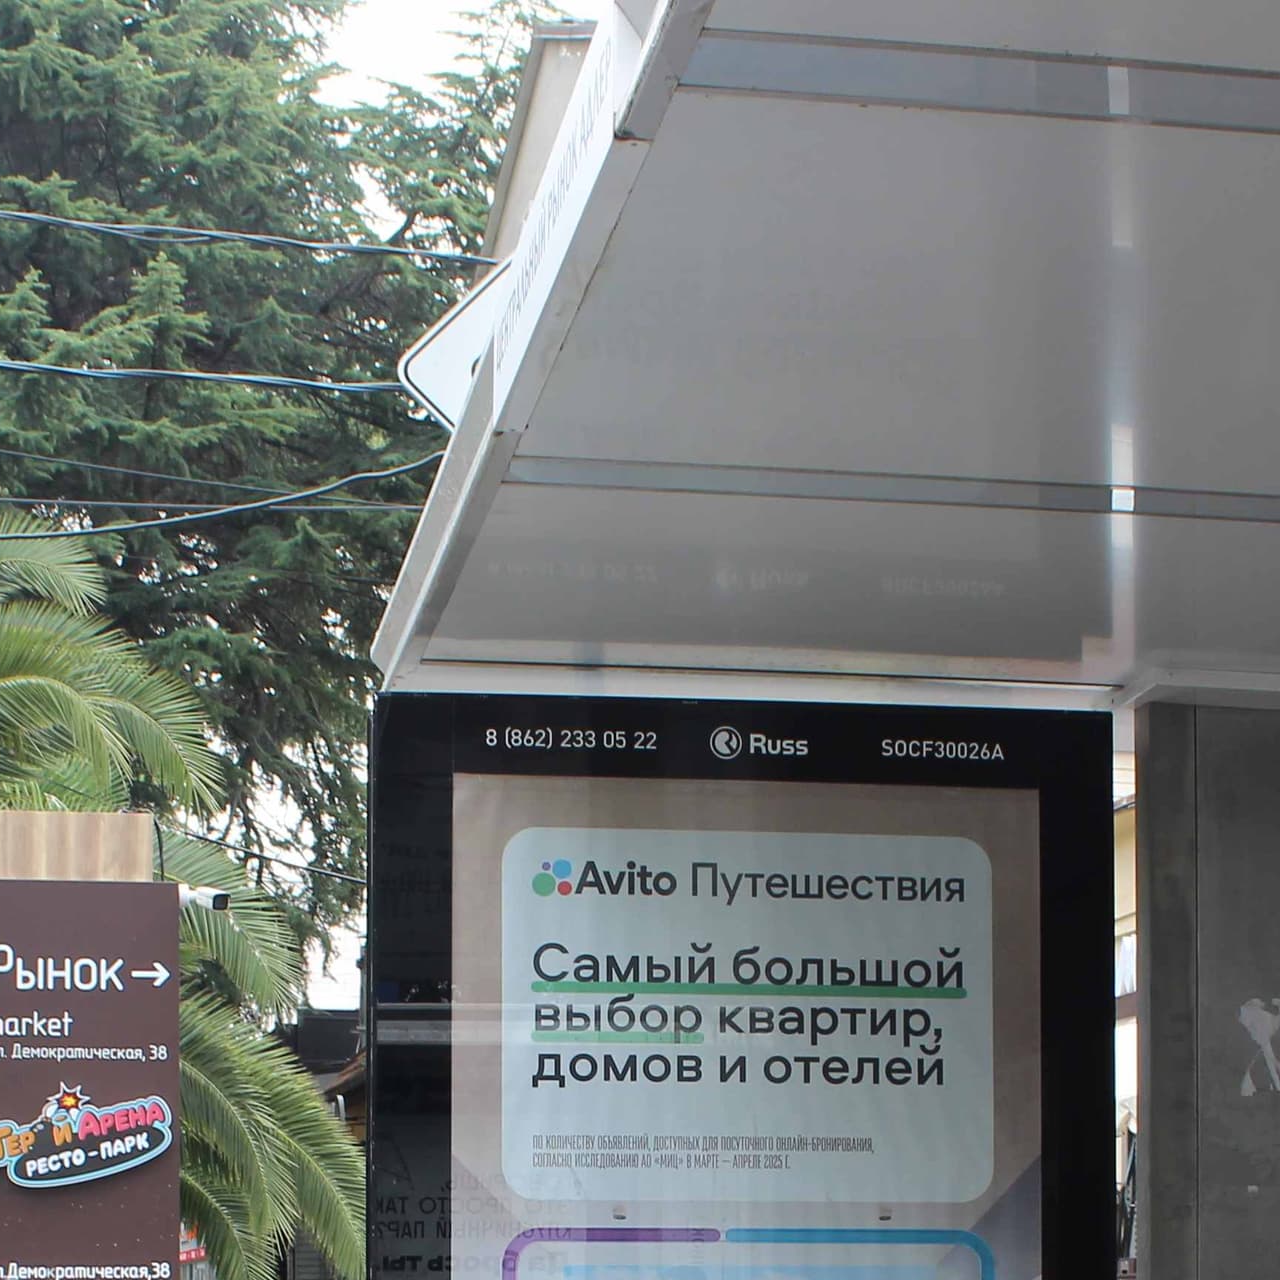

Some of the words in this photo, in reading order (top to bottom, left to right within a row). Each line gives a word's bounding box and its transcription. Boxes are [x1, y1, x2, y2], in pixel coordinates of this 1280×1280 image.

[579, 36, 612, 156] АДЛЕР
[485, 728, 498, 746] 8
[504, 727, 554, 749] (862)
[560, 729, 596, 749] 233
[602, 730, 627, 749] 05
[633, 731, 657, 750] 22
[749, 734, 809, 757] Russ
[881, 738, 1006, 761] SOCF30026A
[575, 860, 678, 896] Avito
[691, 861, 966, 906] Путешествия
[532, 942, 716, 984] Самый
[732, 945, 964, 989] большой
[534, 994, 703, 1044] выбор
[719, 1005, 943, 1048] квартир,
[11, 1043, 147, 1063] Демократическая,
[149, 1044, 168, 1061] 38
[531, 1052, 704, 1089] домов
[720, 1054, 747, 1083] и
[763, 1044, 945, 1086] отелей
[77, 1102, 165, 1141] АРЕНА
[532, 1134, 544, 1150] ПО
[546, 1134, 595, 1151] КОЛИЧЕСТВУ
[653, 1135, 701, 1153] ДОСТУПНЫХ
[702, 1135, 719, 1152] ДЛЯ
[720, 1135, 774, 1152] ПОСУТОЧНОГО
[532, 1152, 572, 1169] СОГЛАСНО
[574, 1153, 639, 1170] ИССЛЕДОВАНИЮ
[641, 1153, 652, 1169] АО
[694, 1154, 720, 1169] МАРТЕ
[732, 1154, 762, 1169] АПРЕЛЕ
[763, 1154, 783, 1169] 2025
